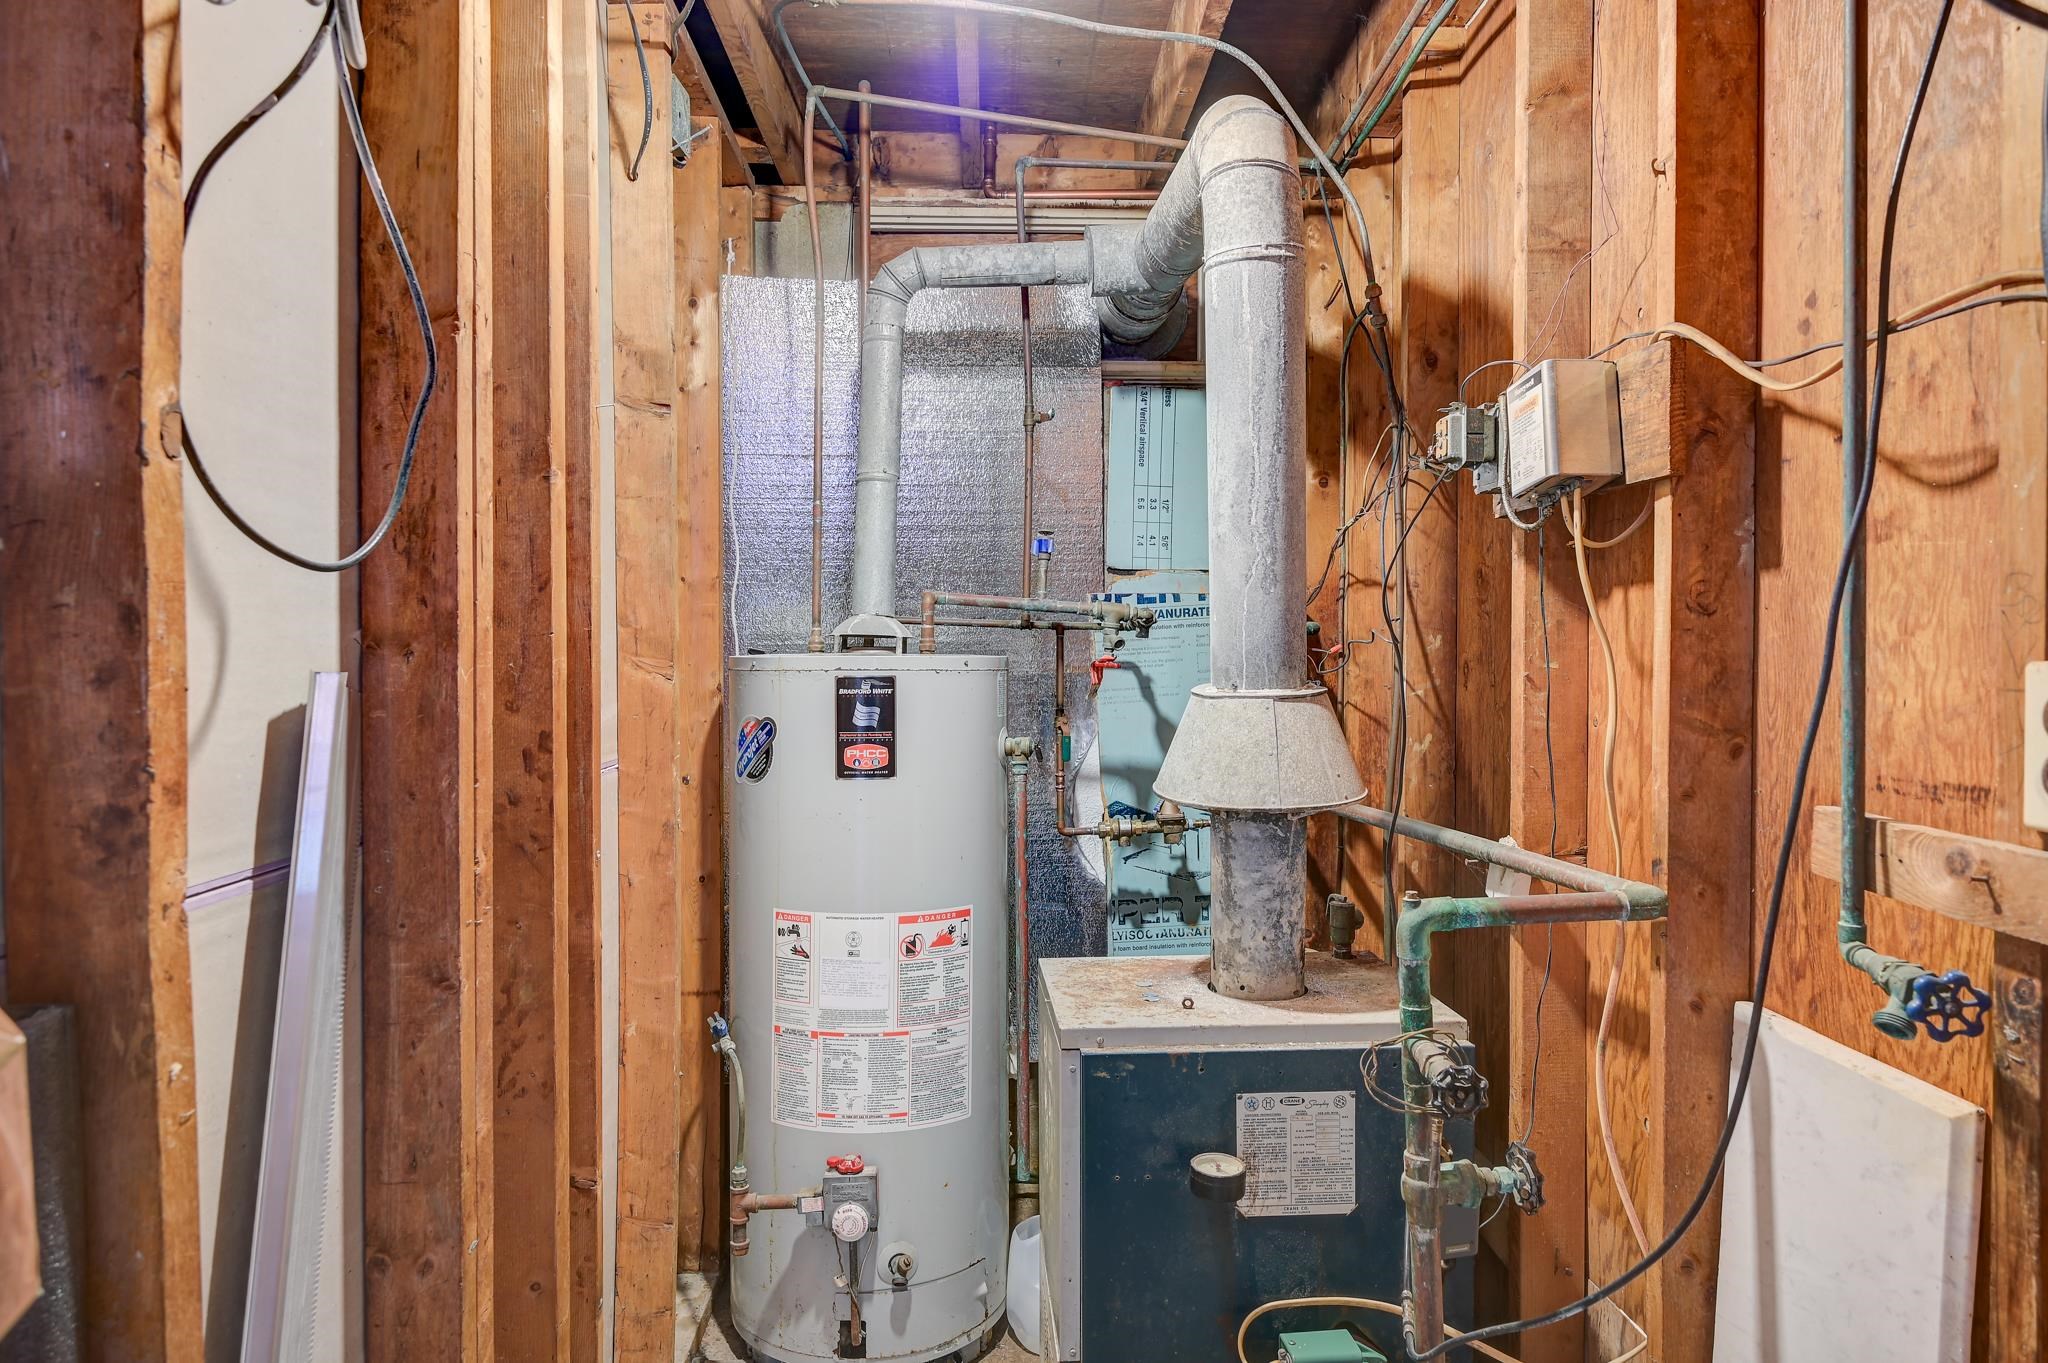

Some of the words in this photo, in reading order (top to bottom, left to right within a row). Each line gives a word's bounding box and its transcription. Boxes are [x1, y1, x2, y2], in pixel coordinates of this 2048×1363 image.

[1138, 436, 1146, 468] airspace
[846, 749, 887, 758] PHCC
[925, 912, 956, 921] DANGER
